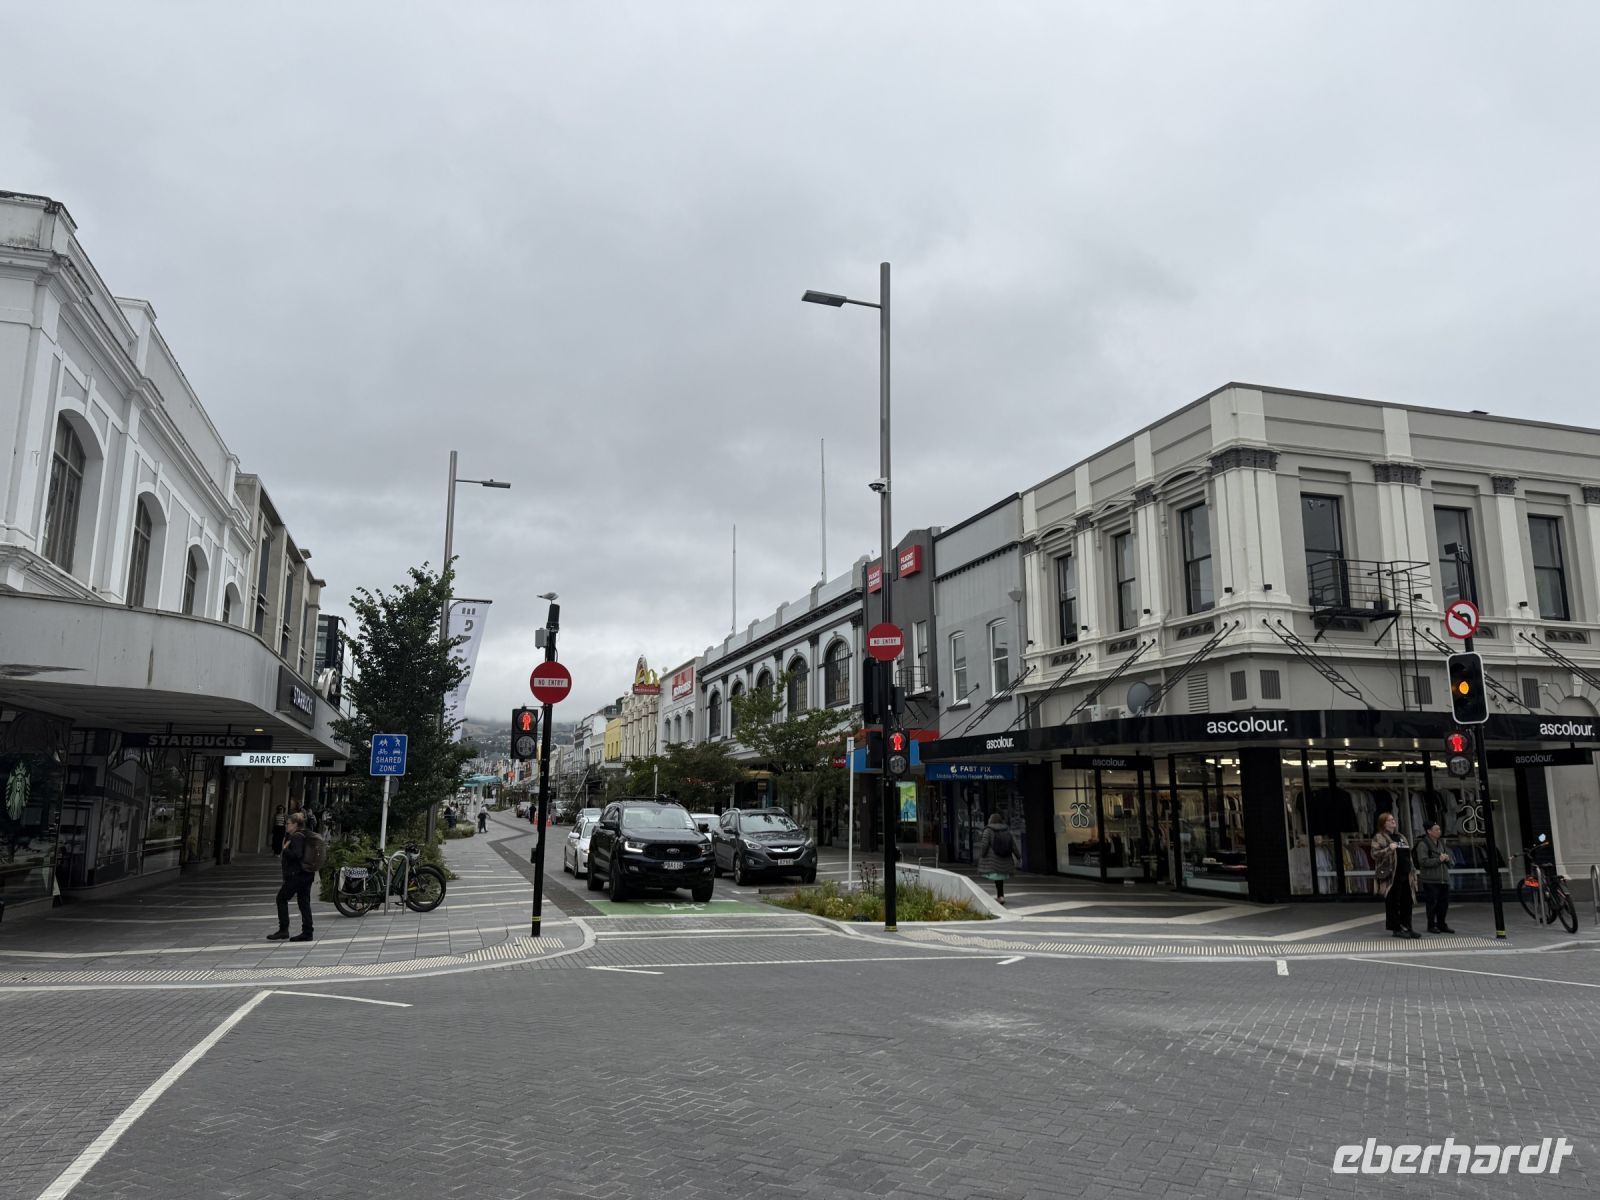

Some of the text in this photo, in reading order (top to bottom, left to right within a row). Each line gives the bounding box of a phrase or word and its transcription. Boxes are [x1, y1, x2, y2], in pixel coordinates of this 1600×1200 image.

[901, 551, 914, 564] FLIGHT
[901, 559, 914, 571] CENTRE
[1206, 716, 1288, 734] ascolour.
[1539, 720, 1596, 736] ascolour.
[148, 734, 248, 747] STARBUCKS
[985, 736, 1015, 750] ascolour.
[375, 756, 402, 764] SHARED
[1092, 757, 1127, 767] ascolour.
[1515, 752, 1555, 764] ascolour.
[960, 765, 992, 773] FAST FIX
